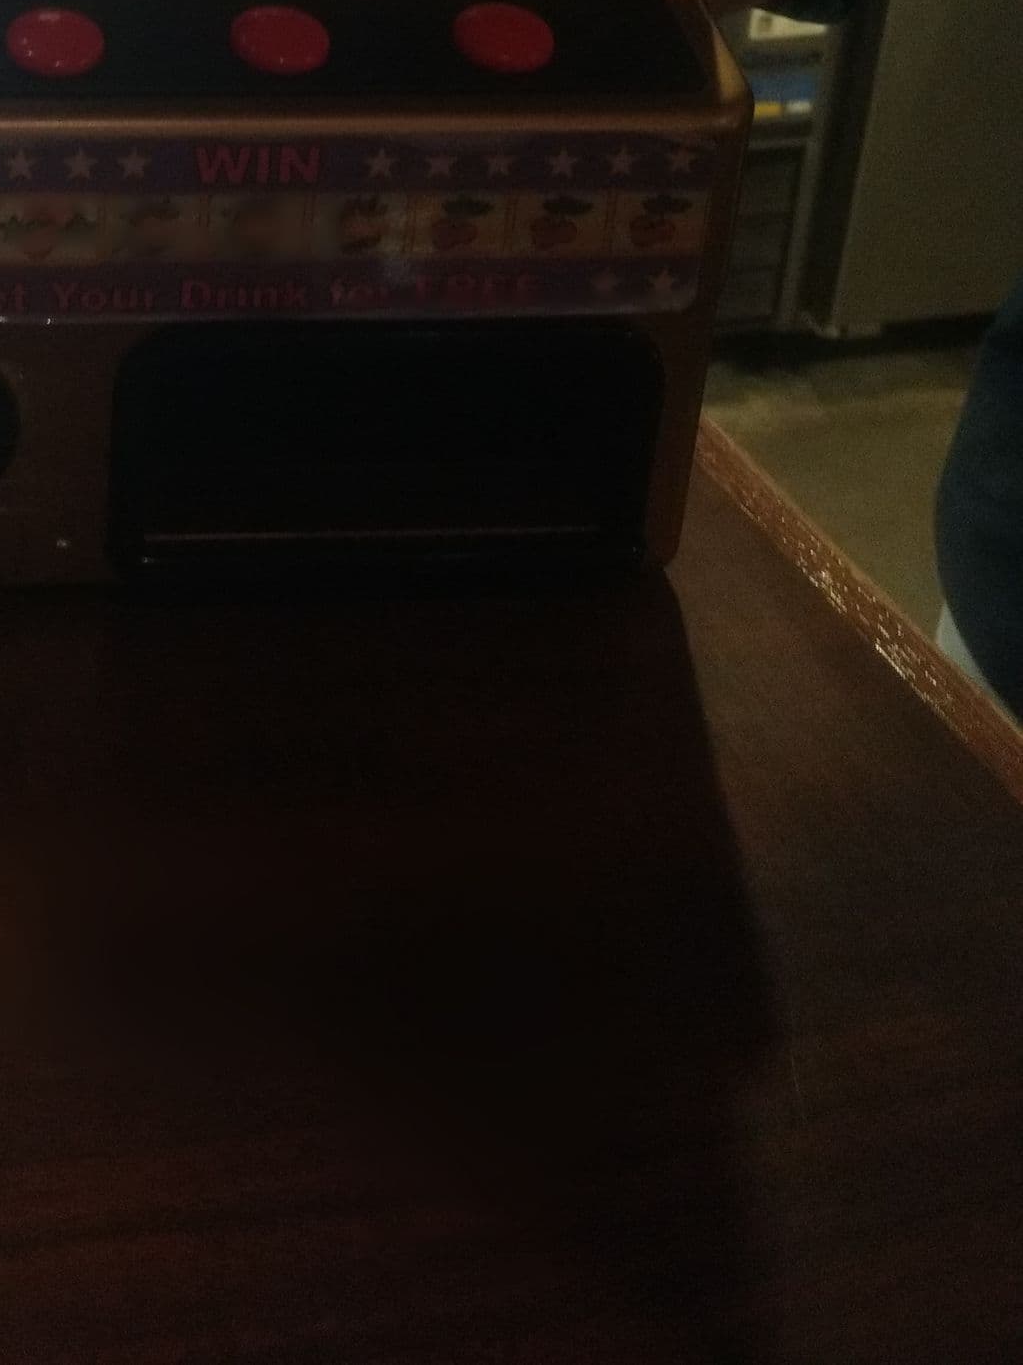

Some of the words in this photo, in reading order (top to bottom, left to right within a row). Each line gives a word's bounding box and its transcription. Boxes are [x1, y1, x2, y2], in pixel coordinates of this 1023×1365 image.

[195, 145, 321, 185] WIN
[52, 281, 157, 313] Your
[180, 277, 308, 309] Drink
